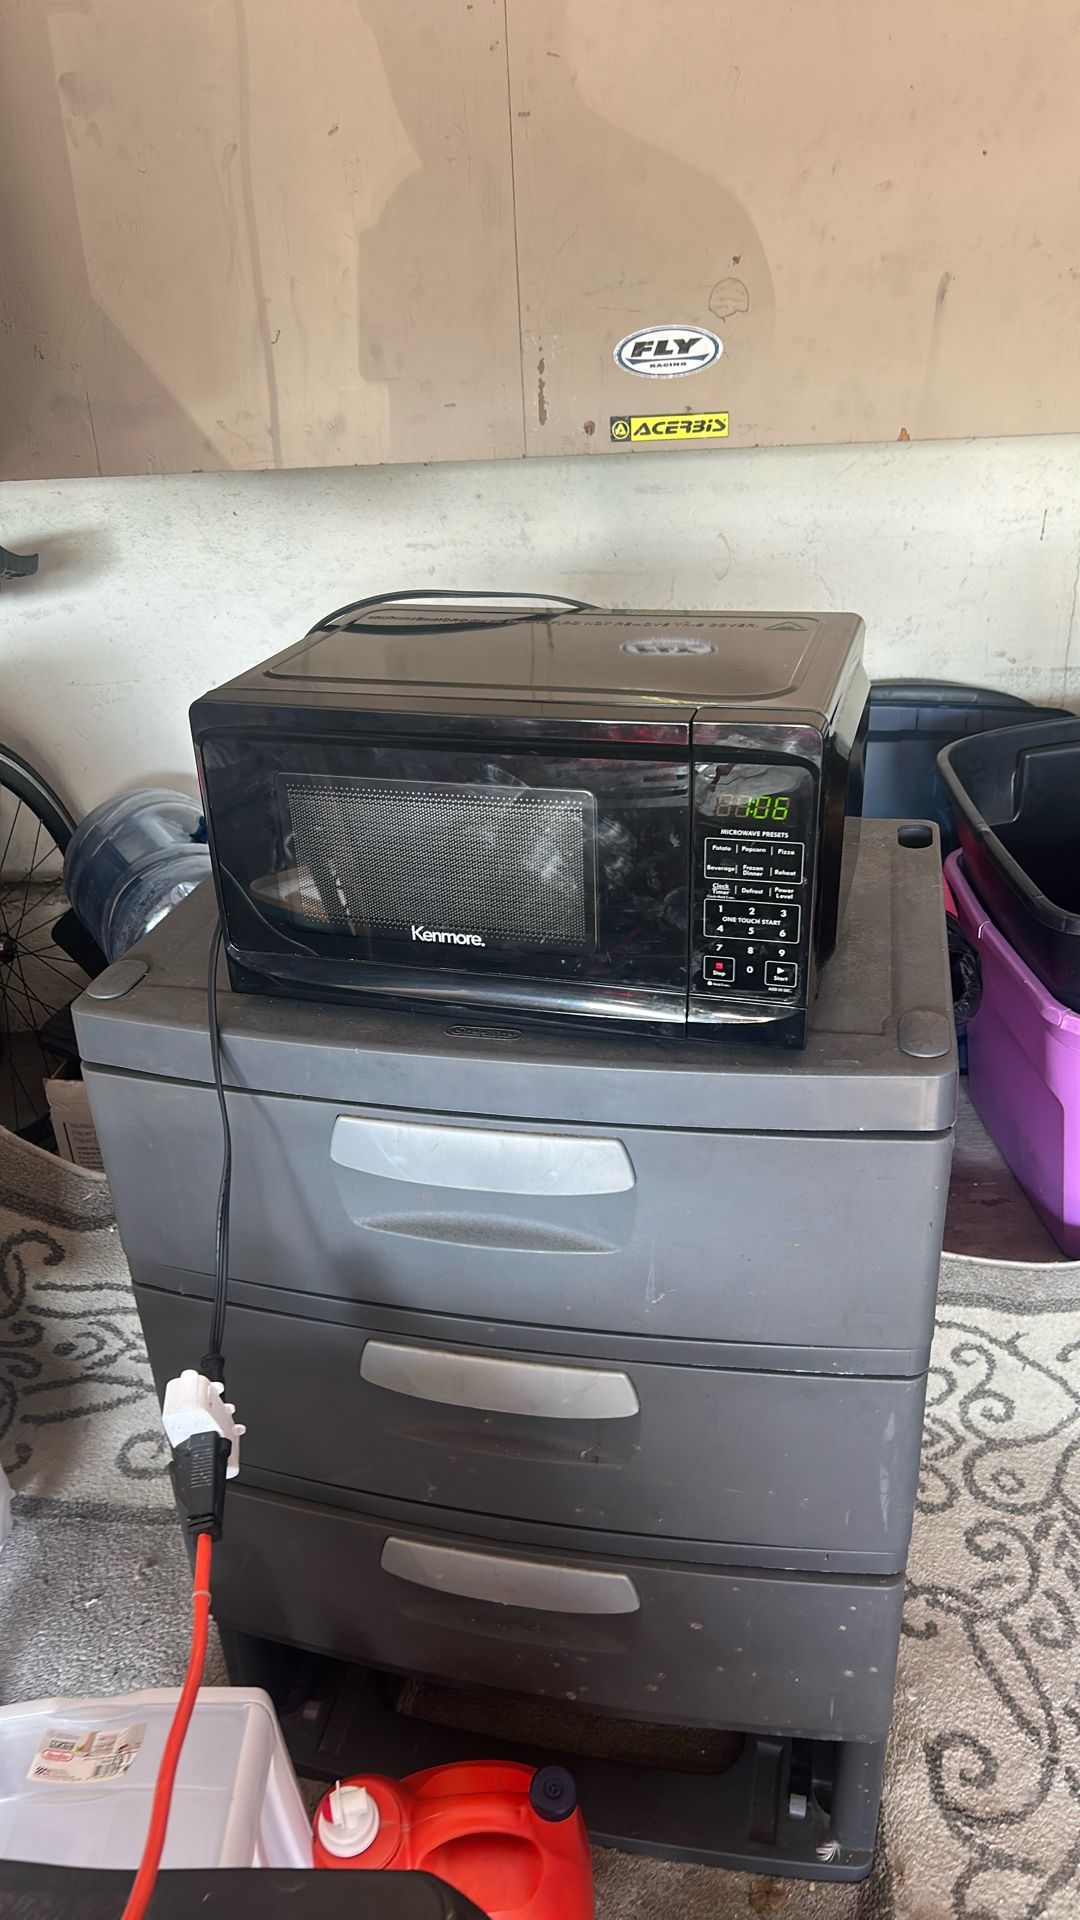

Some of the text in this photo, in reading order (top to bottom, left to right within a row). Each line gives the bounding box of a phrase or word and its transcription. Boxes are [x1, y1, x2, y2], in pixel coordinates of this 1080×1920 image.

[631, 337, 703, 358] FLY
[649, 361, 687, 369] RACING
[745, 796, 790, 821] 1:06
[720, 828, 789, 839] MICROWAVE PRESETS
[711, 844, 732, 852] Potato
[741, 845, 767, 853] Popcorn
[777, 848, 796, 856] Pizza
[706, 864, 735, 873] Beverage
[741, 887, 763, 895] Defrost
[718, 904, 723, 913] 1
[748, 907, 756, 915] 2
[780, 909, 787, 918] 3
[737, 917, 760, 925] TOUCH
[716, 924, 724, 932] 4
[747, 927, 755, 935] 5
[779, 929, 787, 938] 6
[715, 943, 723, 952] 7
[746, 946, 754, 955] 8
[778, 949, 786, 957] 9
[712, 969, 726, 977] Stop
[746, 965, 754, 974] 0
